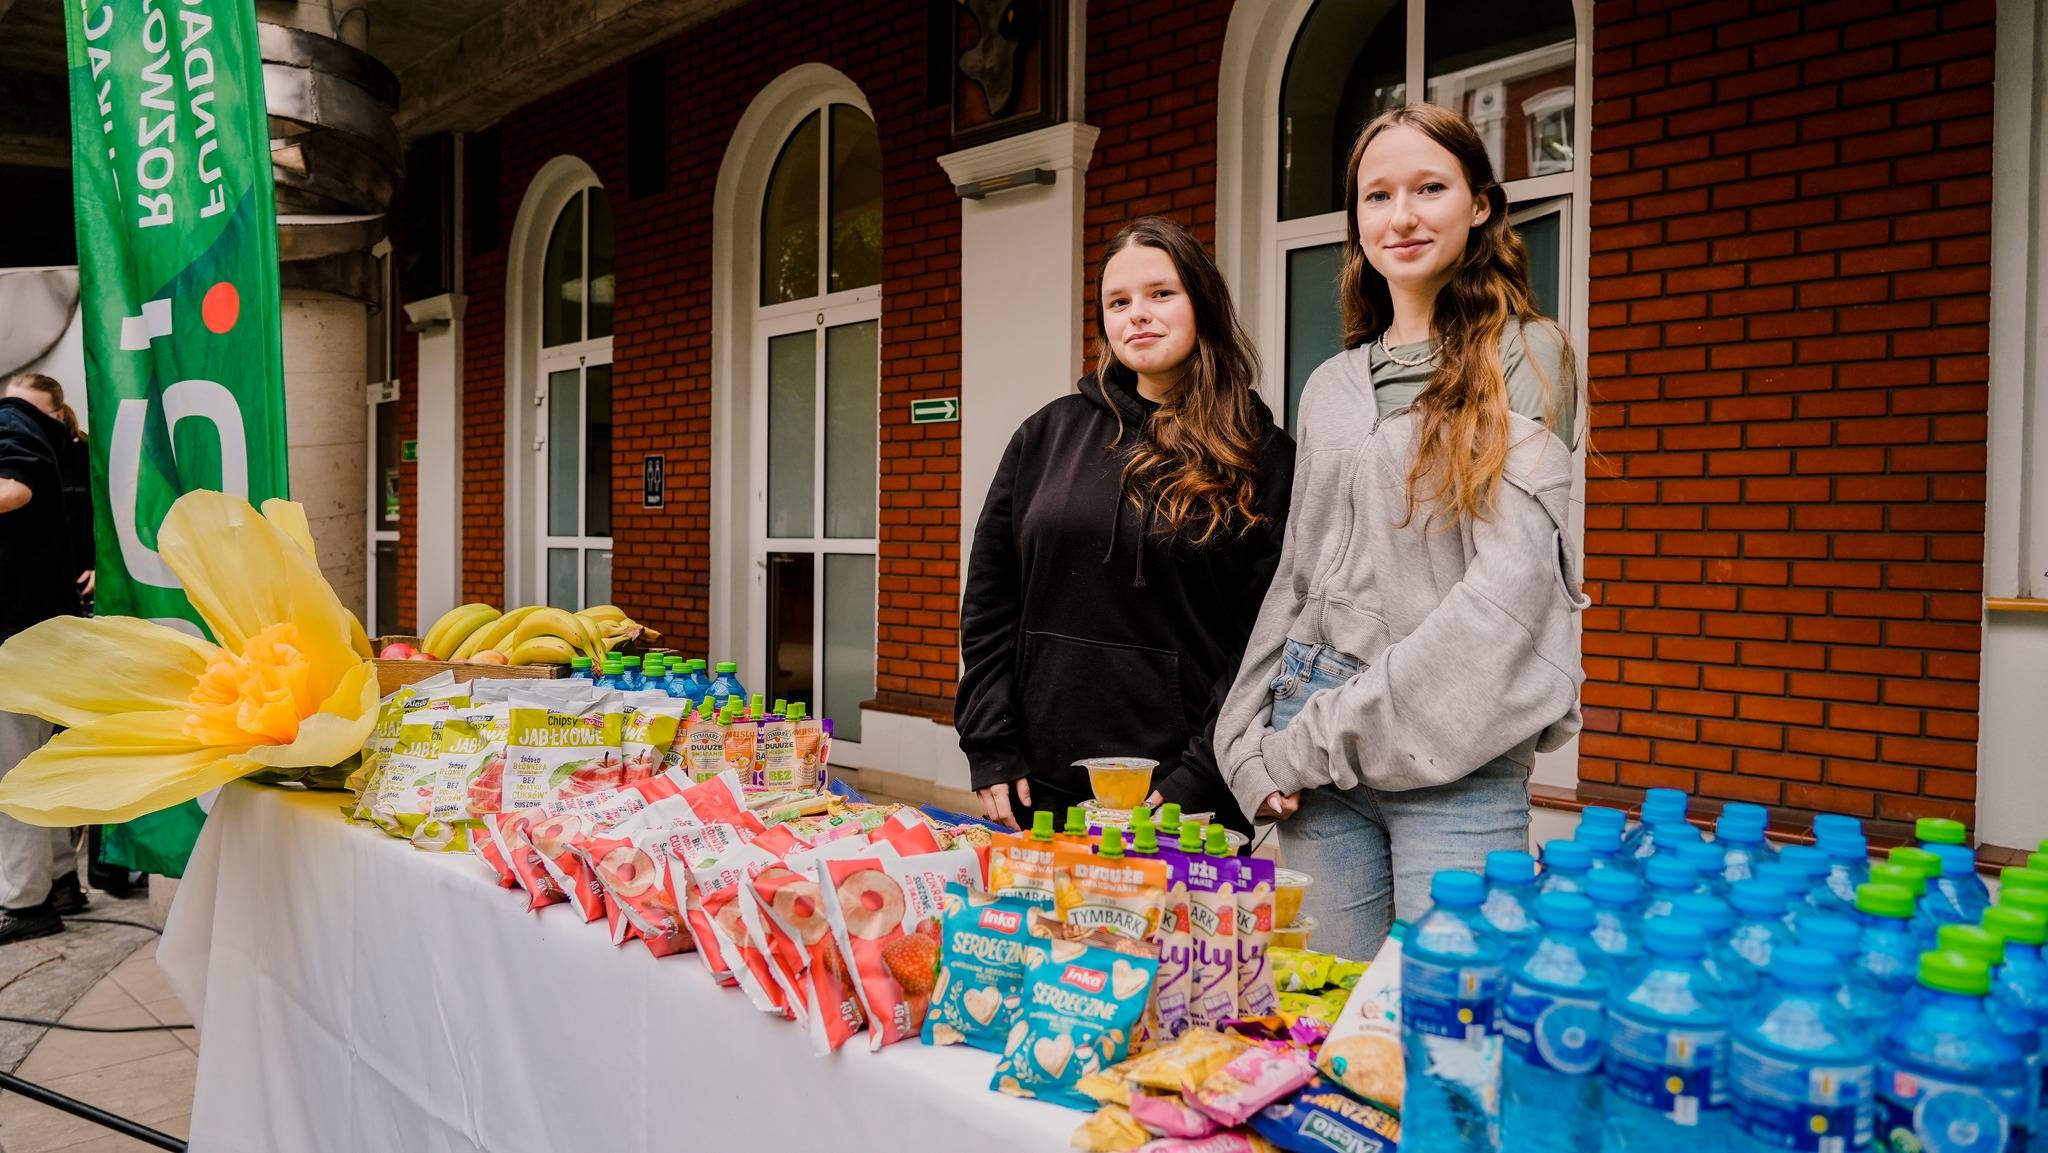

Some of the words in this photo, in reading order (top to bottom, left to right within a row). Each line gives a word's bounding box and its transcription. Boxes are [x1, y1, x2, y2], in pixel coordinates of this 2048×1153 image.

[547, 715, 579, 727] Chipsy
[518, 727, 604, 746] JABŁKOWE
[522, 776, 536, 784] BEZ
[984, 911, 1018, 928] Inka
[1069, 908, 1143, 935] TYMBARK
[952, 931, 1028, 965] SERDECZN
[1066, 967, 1103, 988] Inka
[1032, 981, 1118, 1020] SERDECZNE
